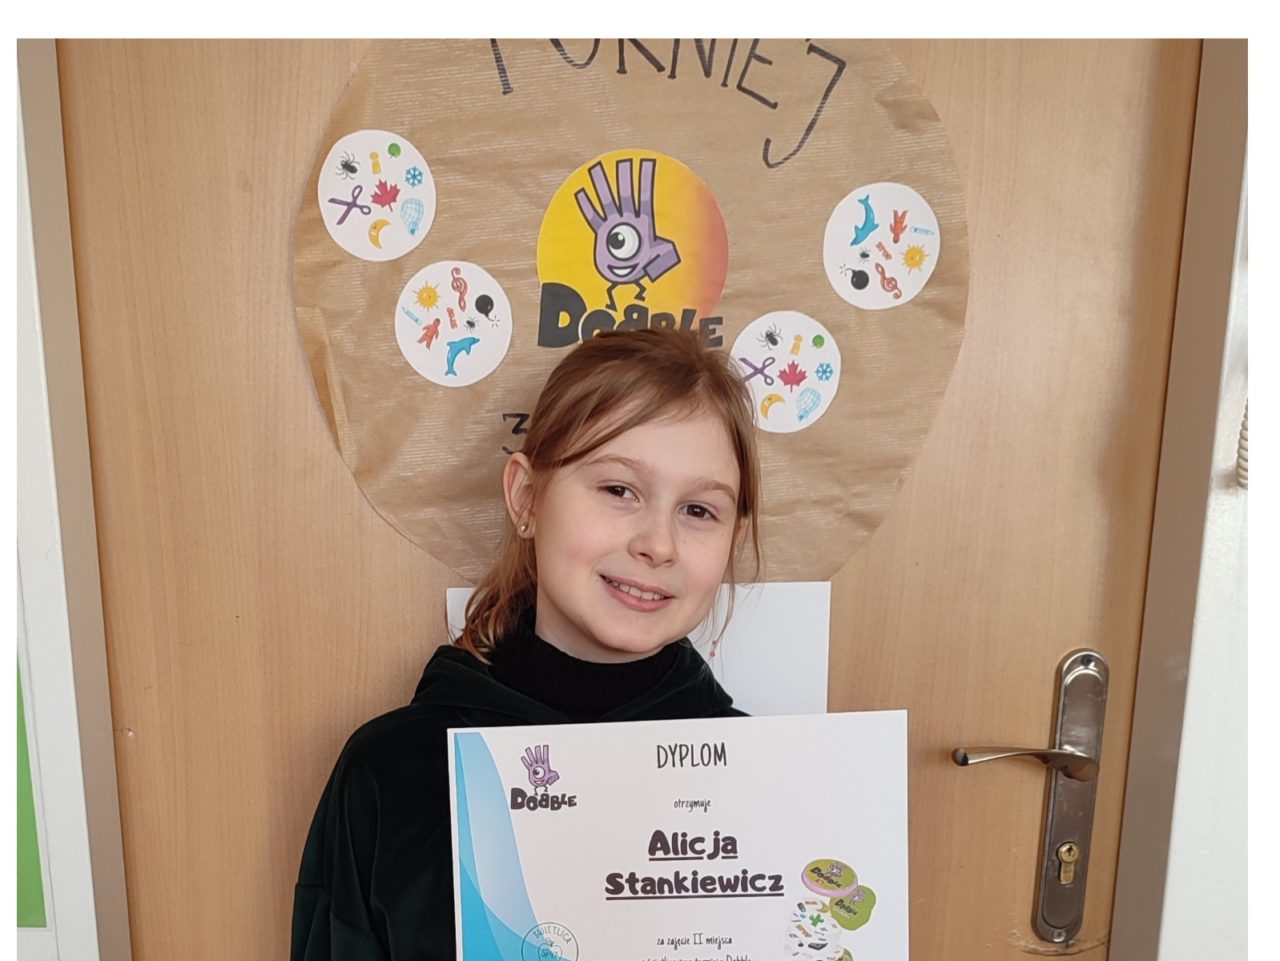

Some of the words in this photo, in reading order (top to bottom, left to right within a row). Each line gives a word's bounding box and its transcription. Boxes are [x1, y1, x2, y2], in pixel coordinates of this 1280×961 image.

[656, 742, 727, 769] DYPLOM
[674, 798, 712, 814] otrzymuje
[648, 829, 738, 862] Alicja
[605, 868, 785, 900] Stankiewicz
[656, 938, 664, 946] za
[666, 936, 690, 951] zajęcie
[692, 932, 704, 946] II
[706, 936, 733, 950] miejsca
